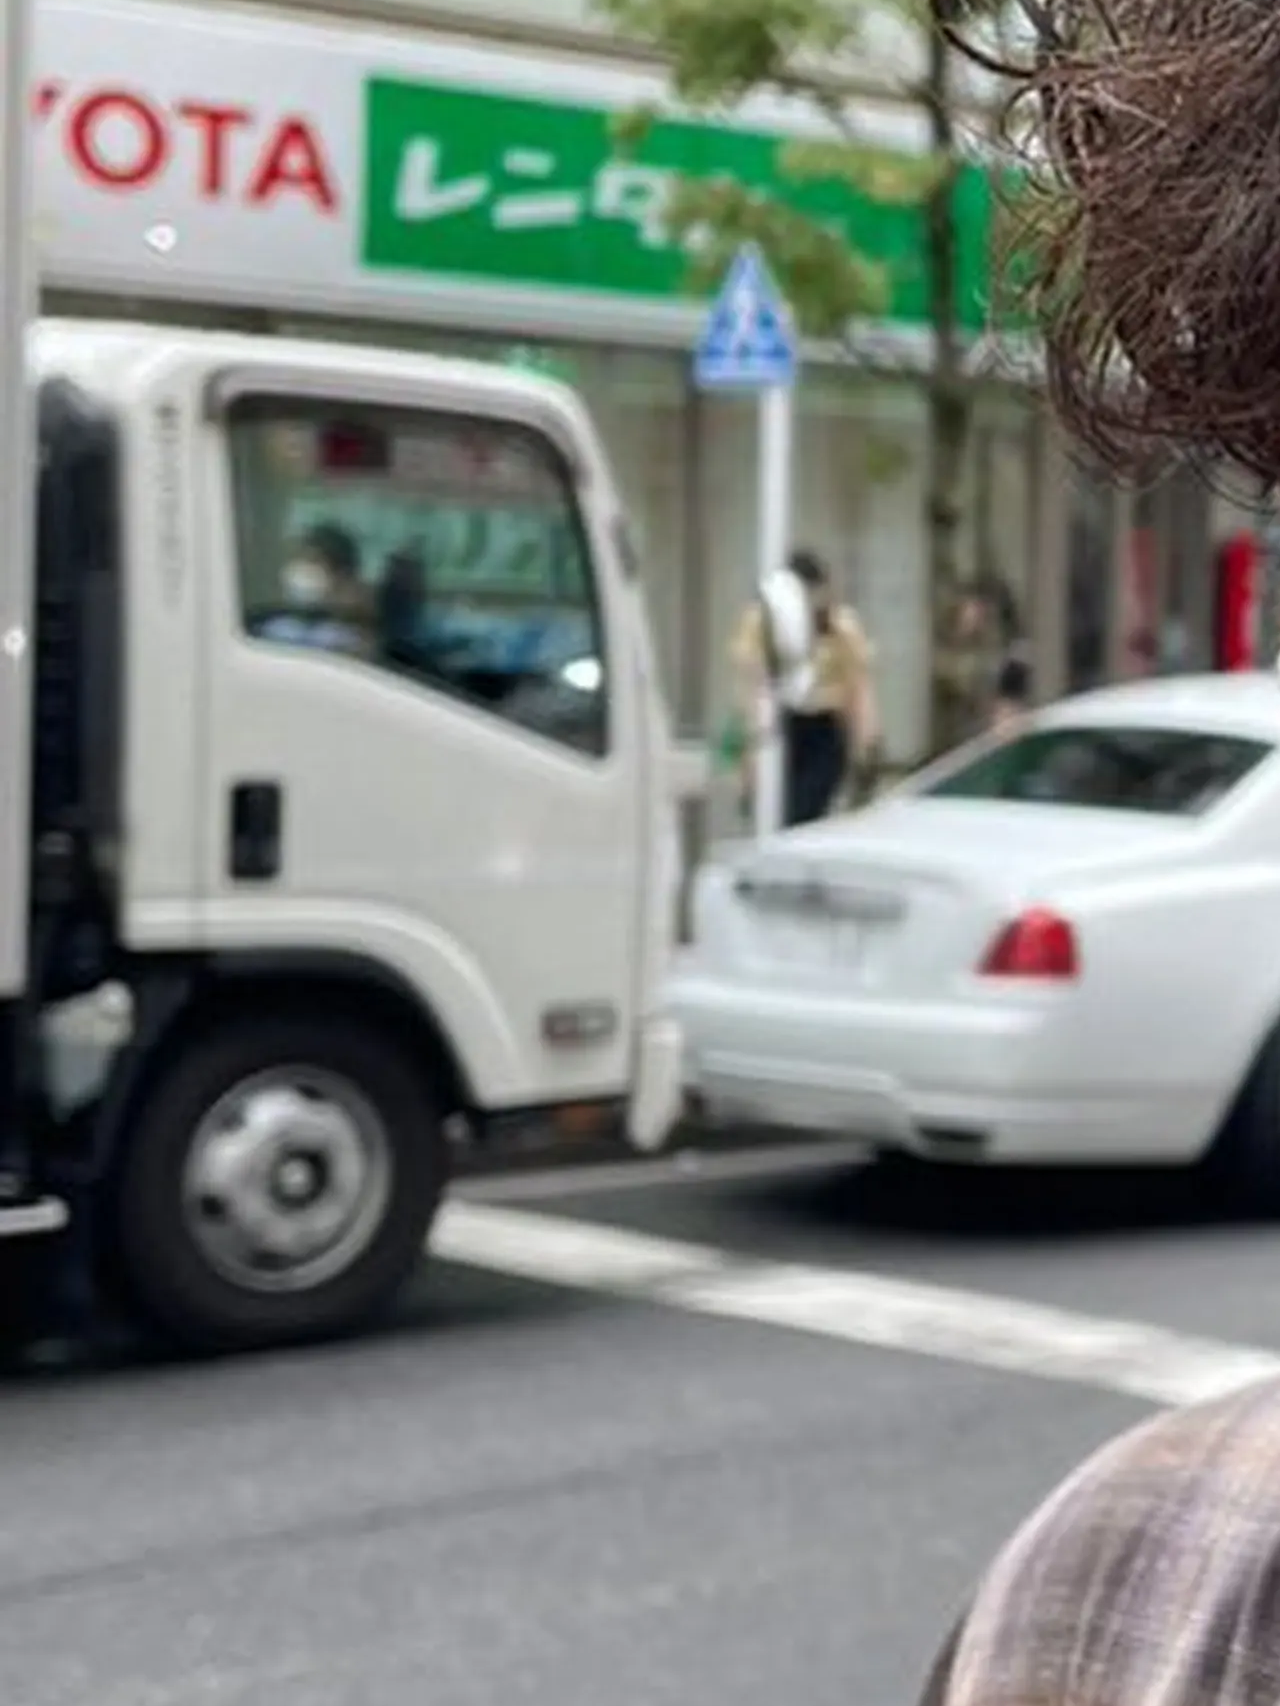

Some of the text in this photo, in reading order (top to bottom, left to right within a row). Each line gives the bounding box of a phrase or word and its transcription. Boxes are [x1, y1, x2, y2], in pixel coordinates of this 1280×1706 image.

[32, 77, 340, 219] OTA
[394, 131, 714, 249] レンタ
